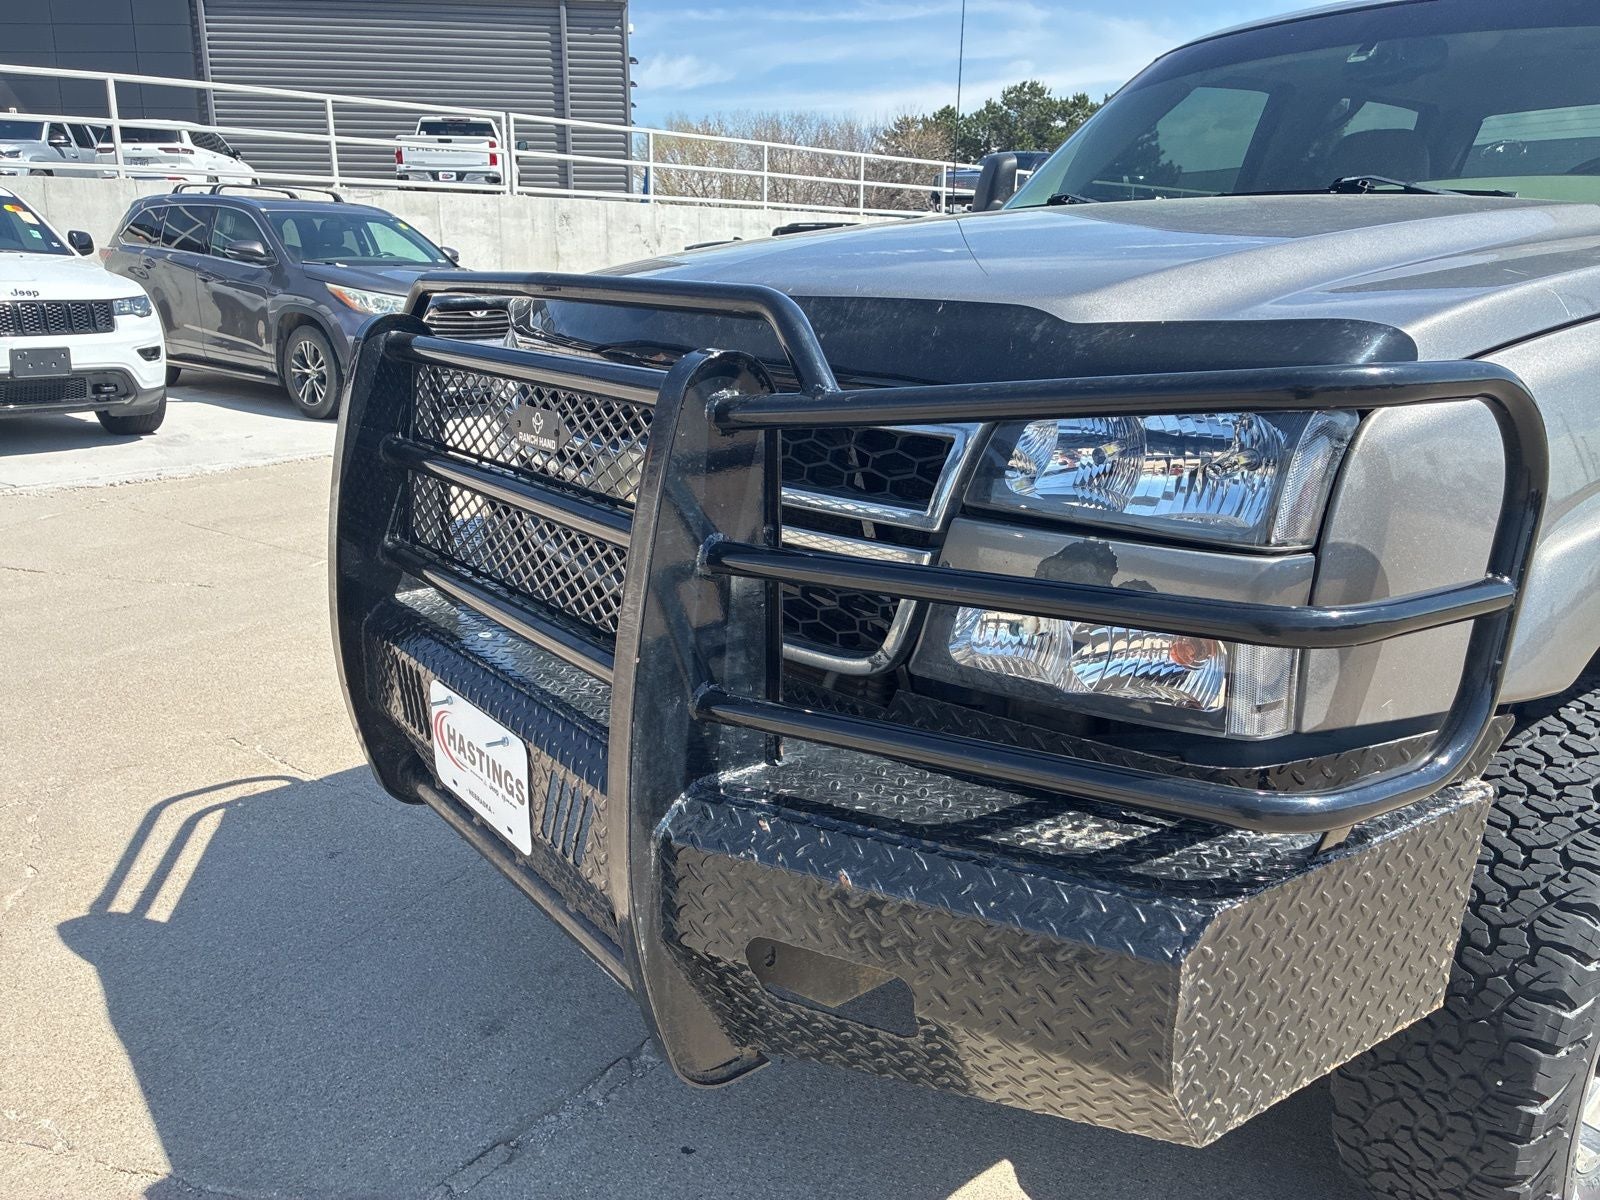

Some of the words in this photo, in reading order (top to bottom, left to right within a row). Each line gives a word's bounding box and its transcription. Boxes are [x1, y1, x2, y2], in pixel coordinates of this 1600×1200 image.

[10, 288, 40, 298] Jeep
[518, 431, 539, 446] RANCH
[538, 436, 556, 450] HAND
[446, 723, 526, 807] HASTINGS
